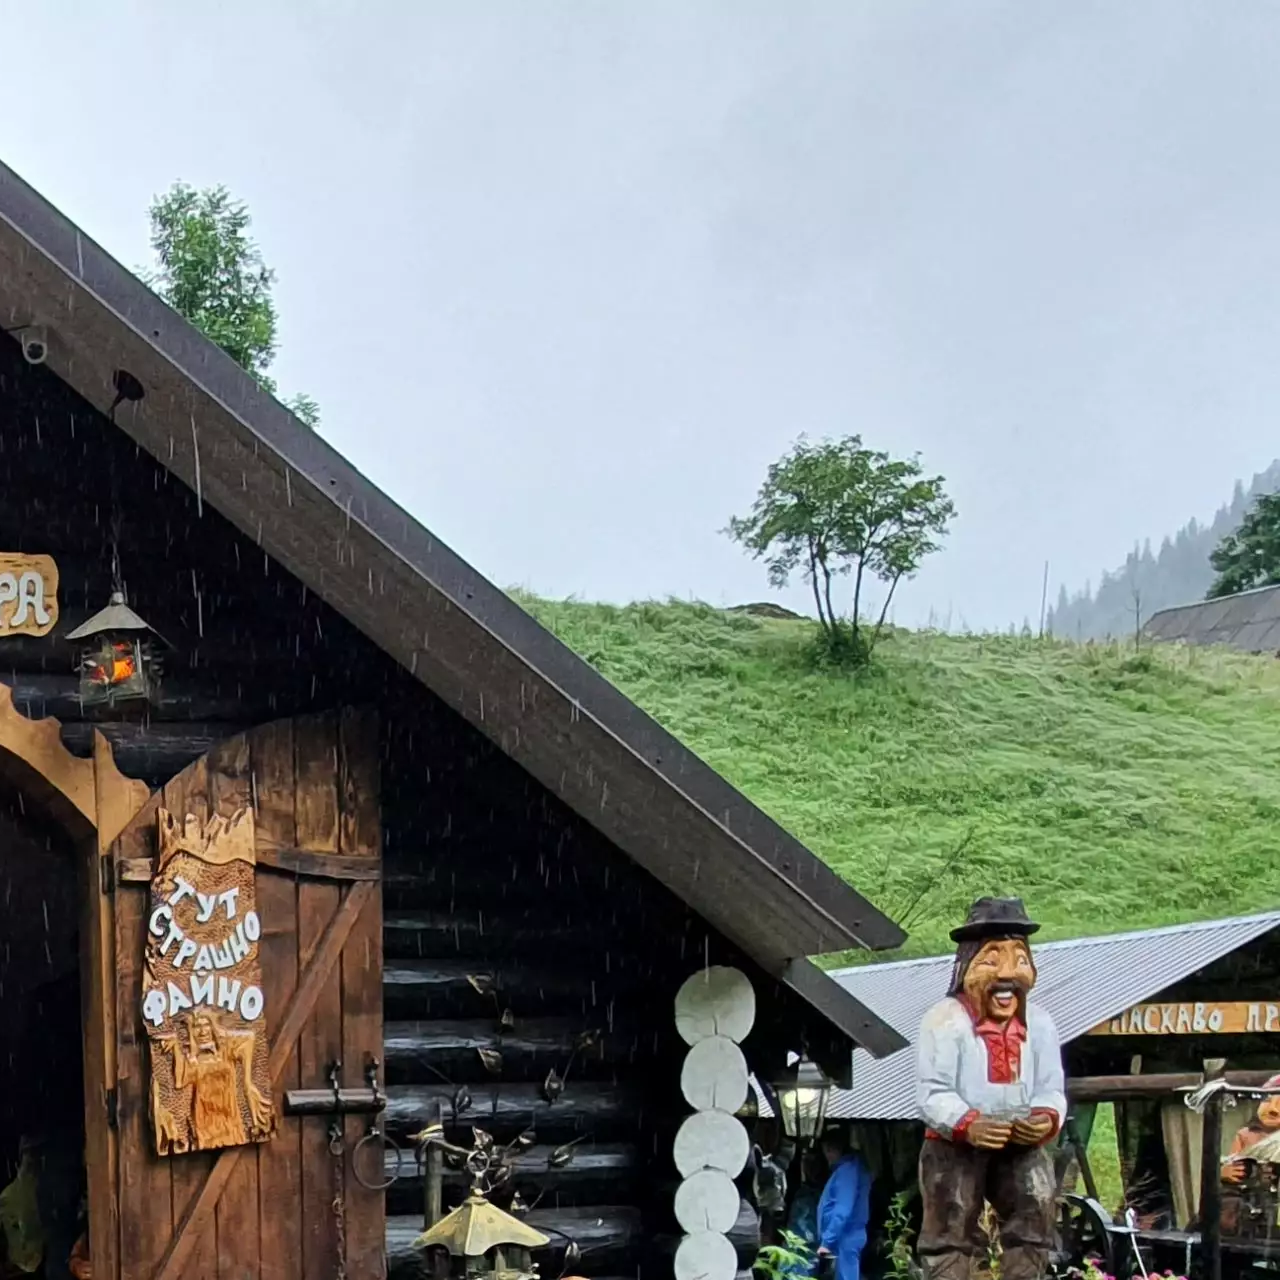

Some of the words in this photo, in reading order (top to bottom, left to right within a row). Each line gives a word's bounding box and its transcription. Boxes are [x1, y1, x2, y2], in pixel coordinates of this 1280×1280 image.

[170, 876, 240, 923] ТУТ
[149, 905, 262, 972] СТРАШНО
[142, 971, 264, 1027] ФАЙНО
